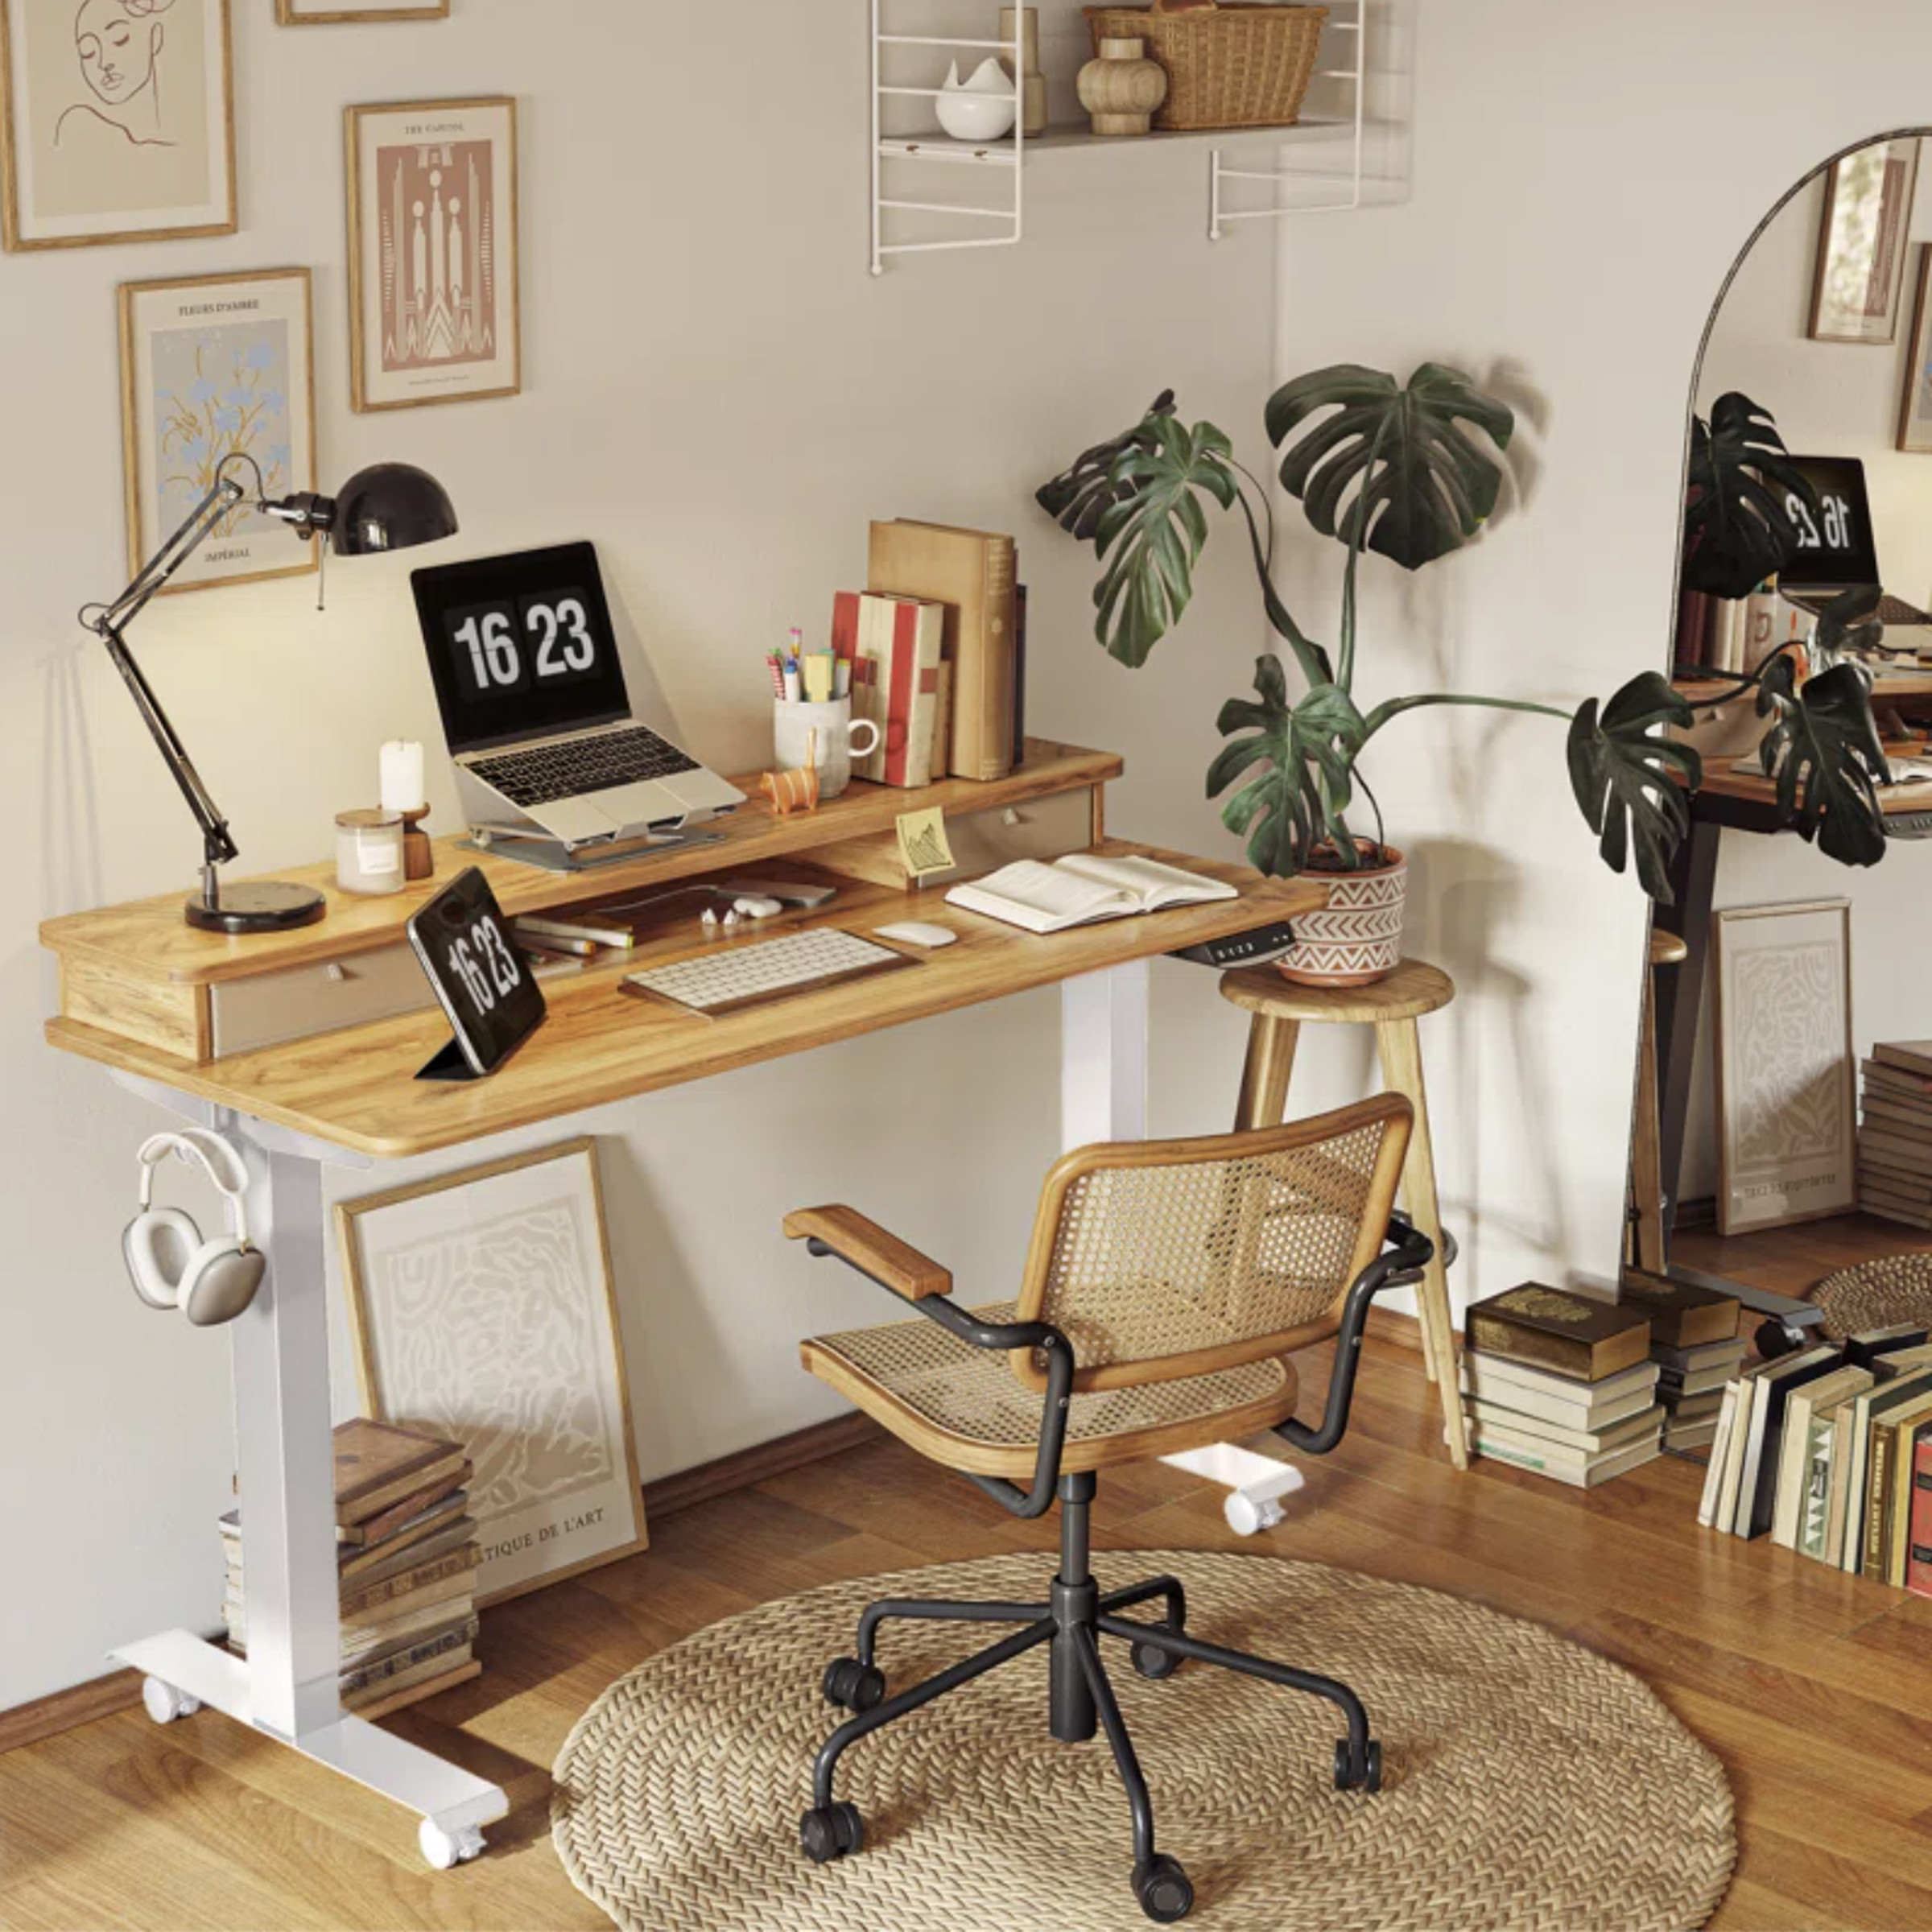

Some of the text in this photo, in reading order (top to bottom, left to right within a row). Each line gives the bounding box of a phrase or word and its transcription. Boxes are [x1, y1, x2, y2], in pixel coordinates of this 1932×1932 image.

[454, 597, 594, 688] 16 23
[448, 915, 521, 1016] 16 23
[539, 1523, 560, 1542] DE
[564, 1508, 604, 1533] L'ART
